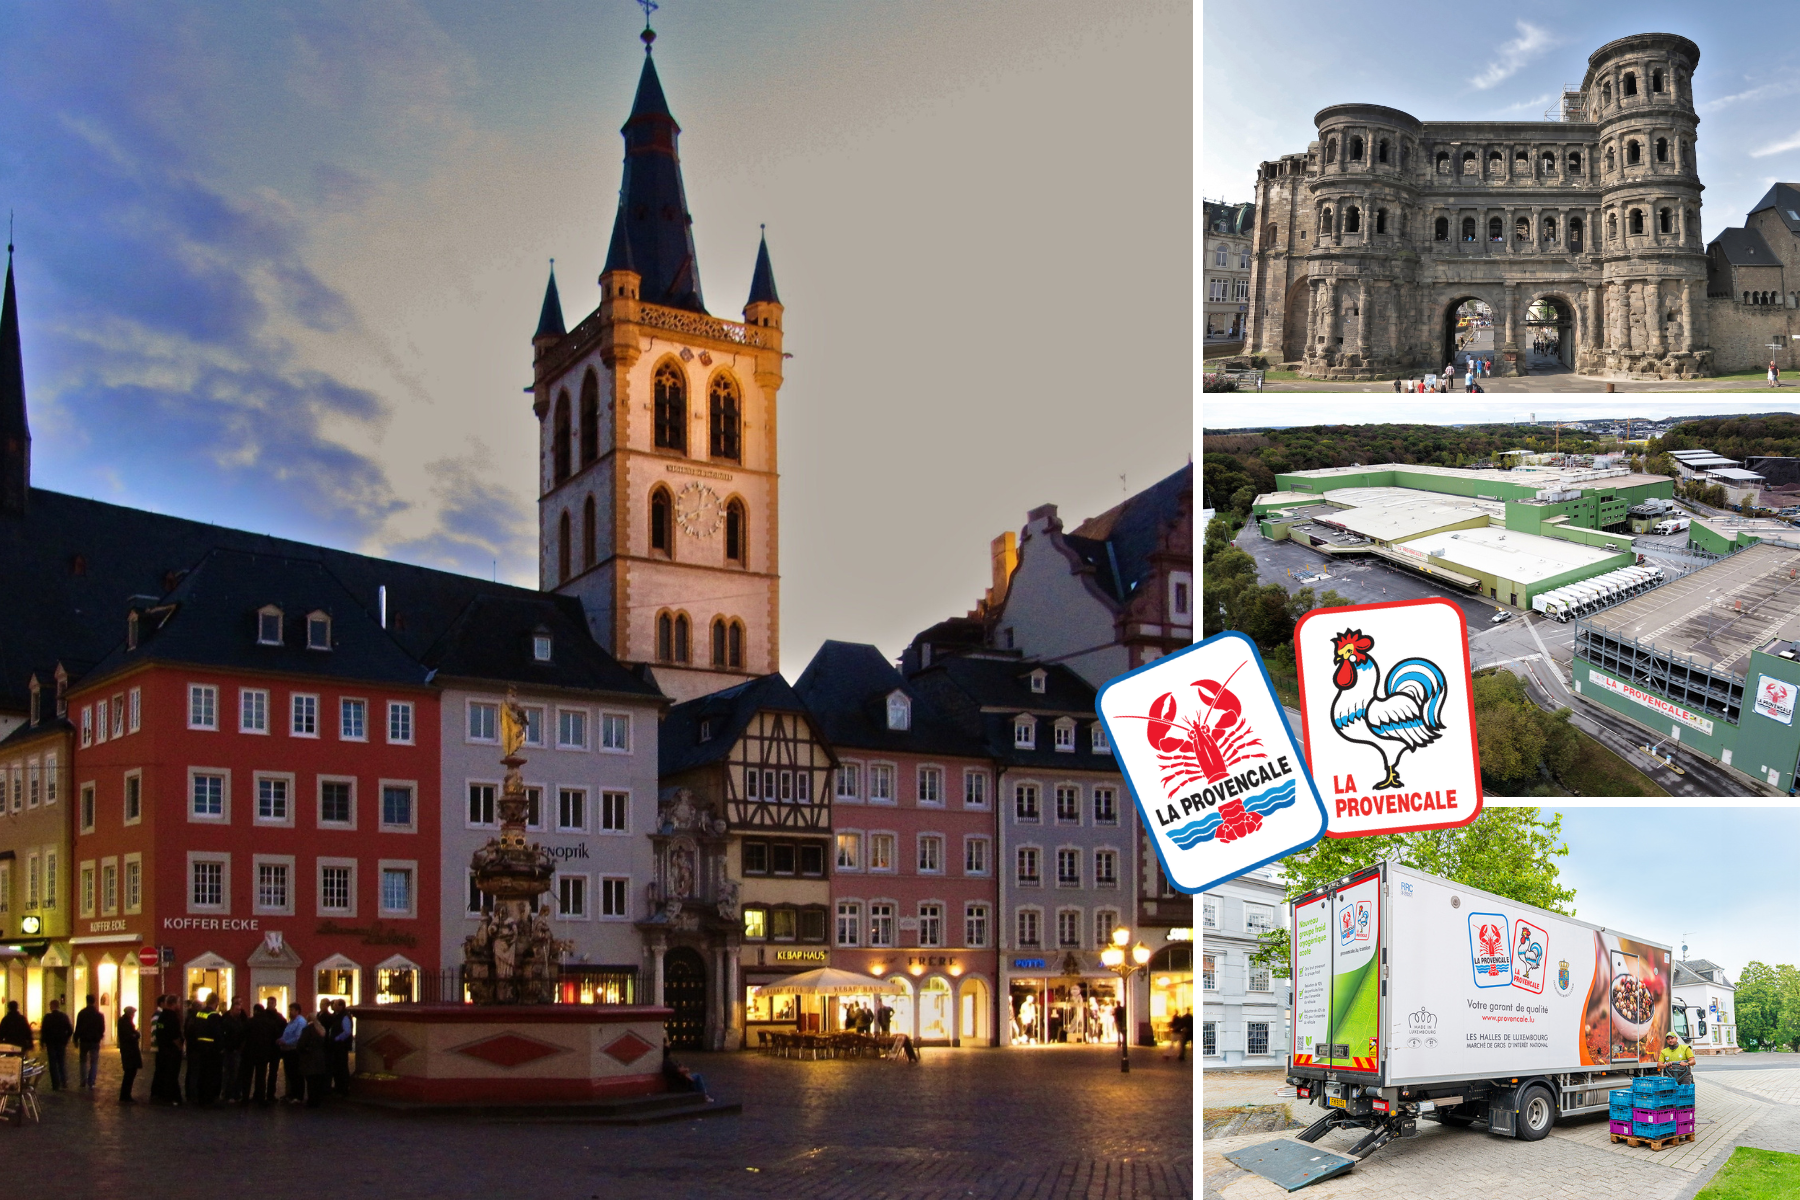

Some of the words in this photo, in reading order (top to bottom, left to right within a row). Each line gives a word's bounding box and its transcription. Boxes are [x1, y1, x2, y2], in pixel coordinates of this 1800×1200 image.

[1606, 677, 1617, 689] LA
[1623, 684, 1690, 720] PROVENCALE
[90, 920, 111, 932] KOFFER
[111, 919, 127, 931] ECKE
[164, 918, 219, 930] KOFFER
[222, 919, 259, 931] ECKE
[777, 951, 802, 960] KEBAP
[803, 951, 825, 960] HAUS
[1474, 957, 1480, 965] LA
[1481, 956, 1510, 964] PROVENCALE
[1514, 967, 1520, 976] LA
[1513, 975, 1540, 990] PROVENCALE
[1467, 999, 1488, 1010] Votre
[1489, 1003, 1513, 1012] garant
[1515, 1003, 1525, 1012] de
[1526, 1004, 1549, 1014] qualité
[1482, 1015, 1535, 1023] www.provencale.lu
[1466, 1033, 1477, 1041] LES
[1479, 1033, 1502, 1041] HALLES
[1503, 1033, 1511, 1041] DE
[1513, 1033, 1549, 1041] LUXEMBOURG
